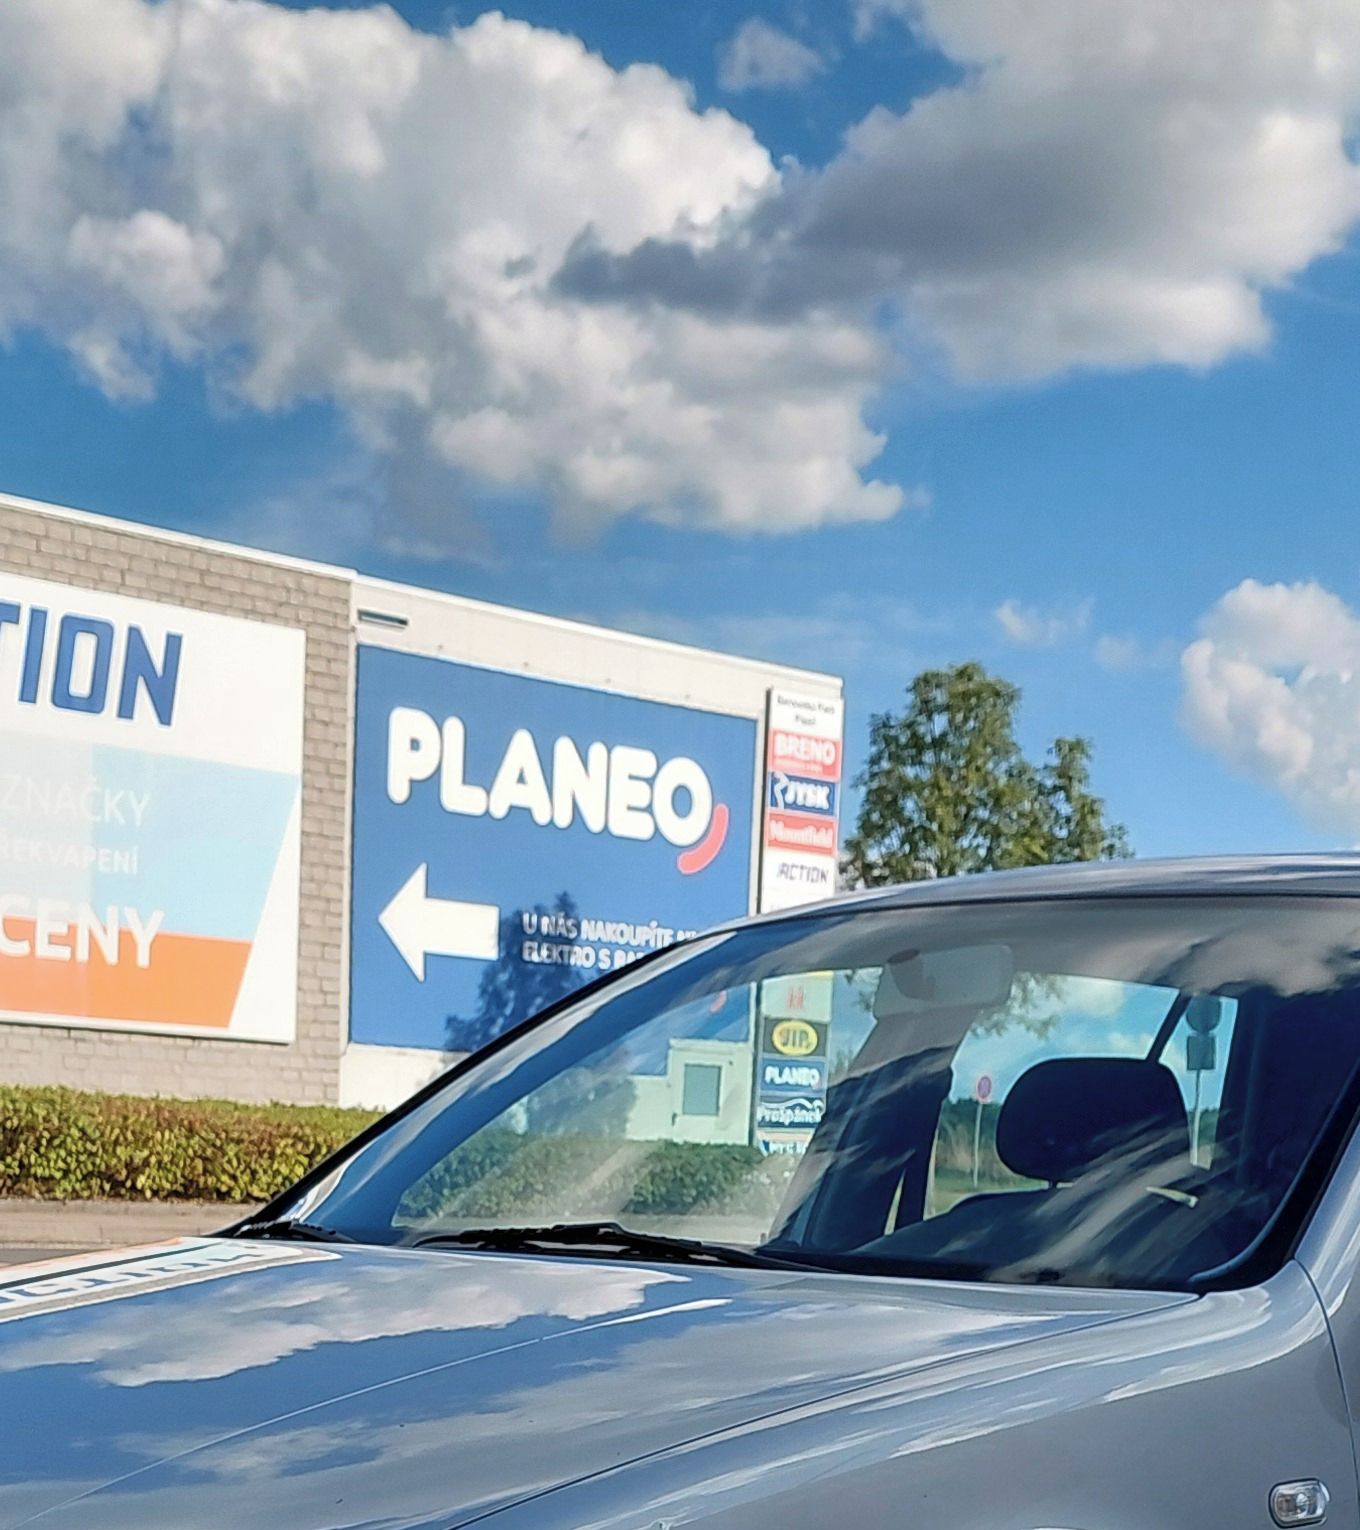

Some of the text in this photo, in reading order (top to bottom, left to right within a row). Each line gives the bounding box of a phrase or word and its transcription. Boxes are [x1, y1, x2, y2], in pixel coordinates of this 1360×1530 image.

[774, 733, 836, 766] BRENO
[387, 706, 713, 847] PLANEO
[1, 774, 151, 827] ZNAČKY
[777, 861, 829, 884] ACTION
[522, 912, 537, 934] U
[541, 911, 578, 939] NÁS
[580, 917, 675, 949] NAKOUPÍTE
[522, 940, 596, 970] ELEKTRO
[598, 948, 611, 970] S
[764, 1066, 821, 1088] PLANEO
